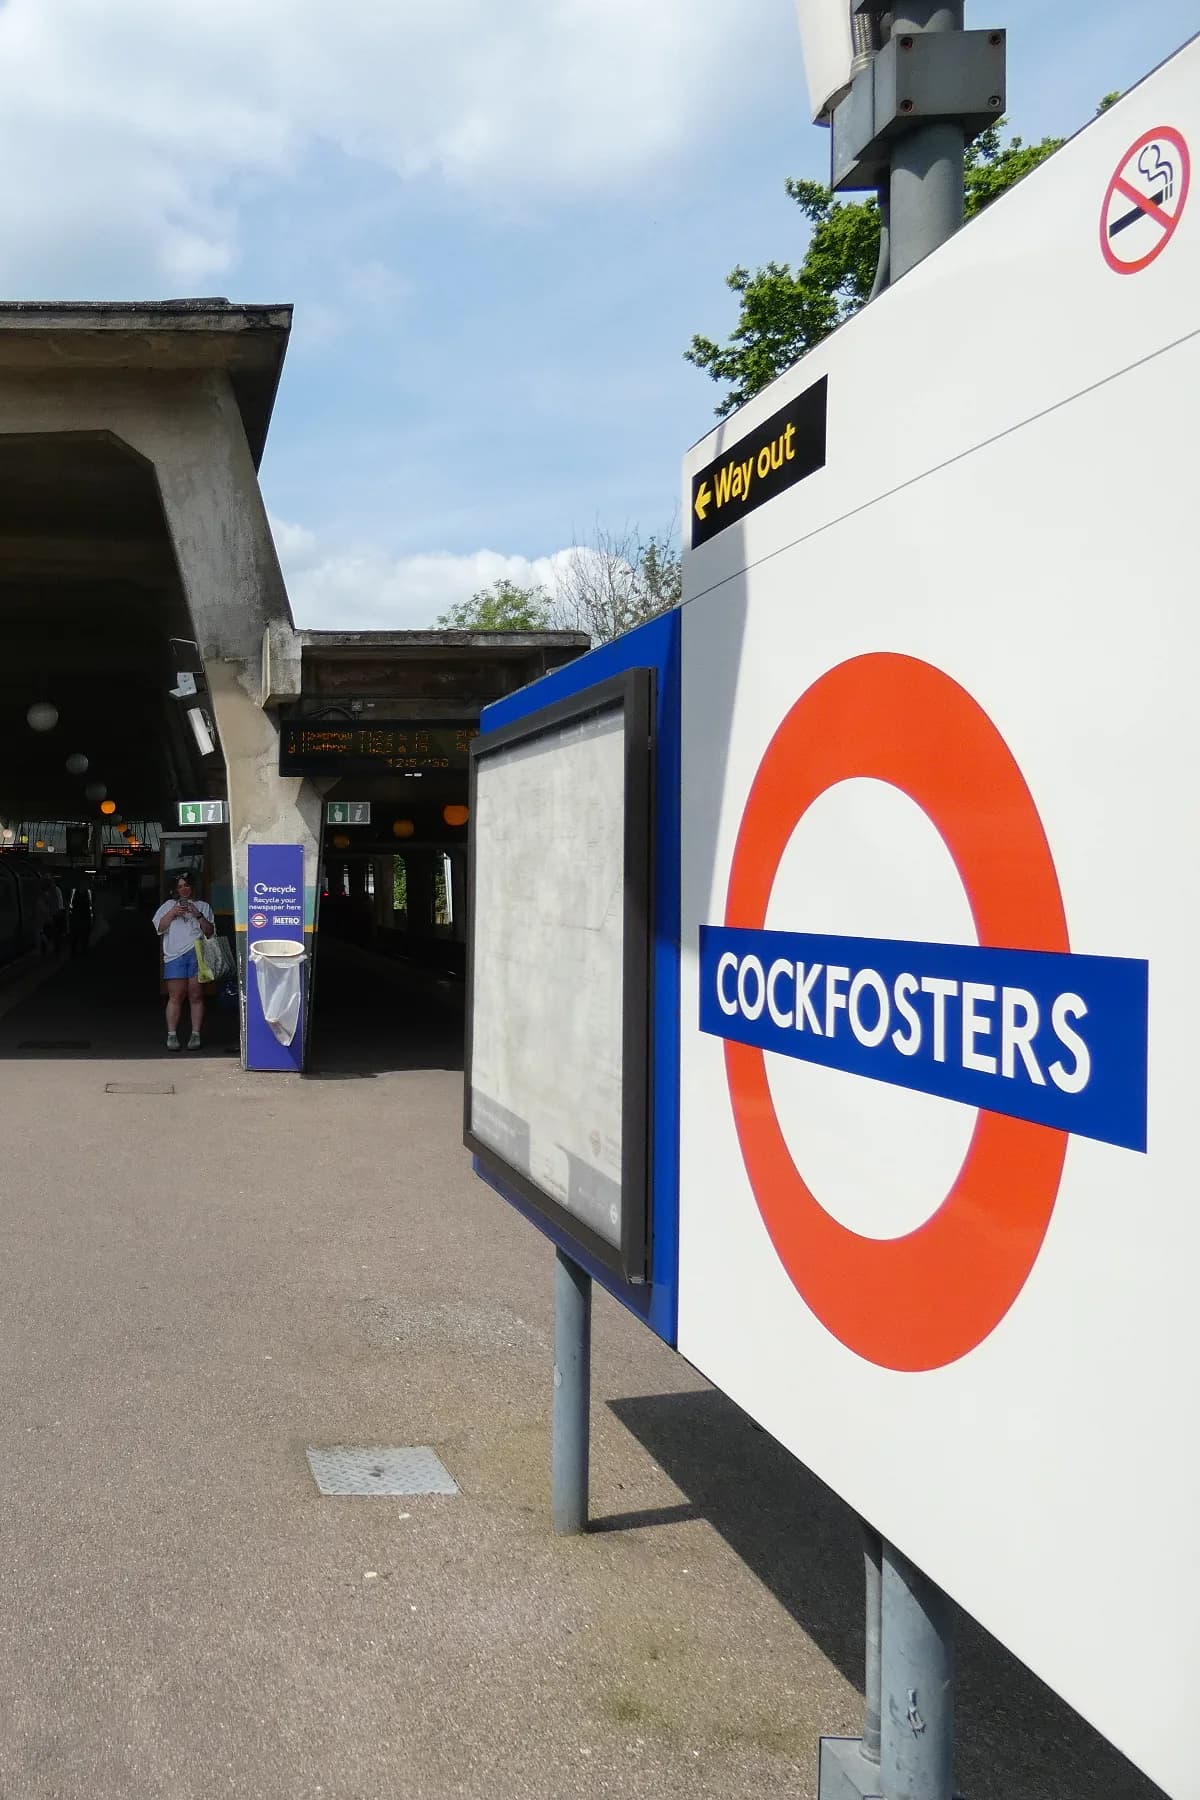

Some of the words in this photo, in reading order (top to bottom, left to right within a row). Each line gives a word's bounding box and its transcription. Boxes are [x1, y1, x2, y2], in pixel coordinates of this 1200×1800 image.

[714, 457, 754, 508] Way
[757, 422, 796, 479] out
[268, 884, 297, 895] recycle
[253, 896, 280, 905] Recycle
[280, 897, 297, 905] your
[274, 916, 300, 925] METRO
[716, 951, 1091, 1094] COCKFOSTERS
